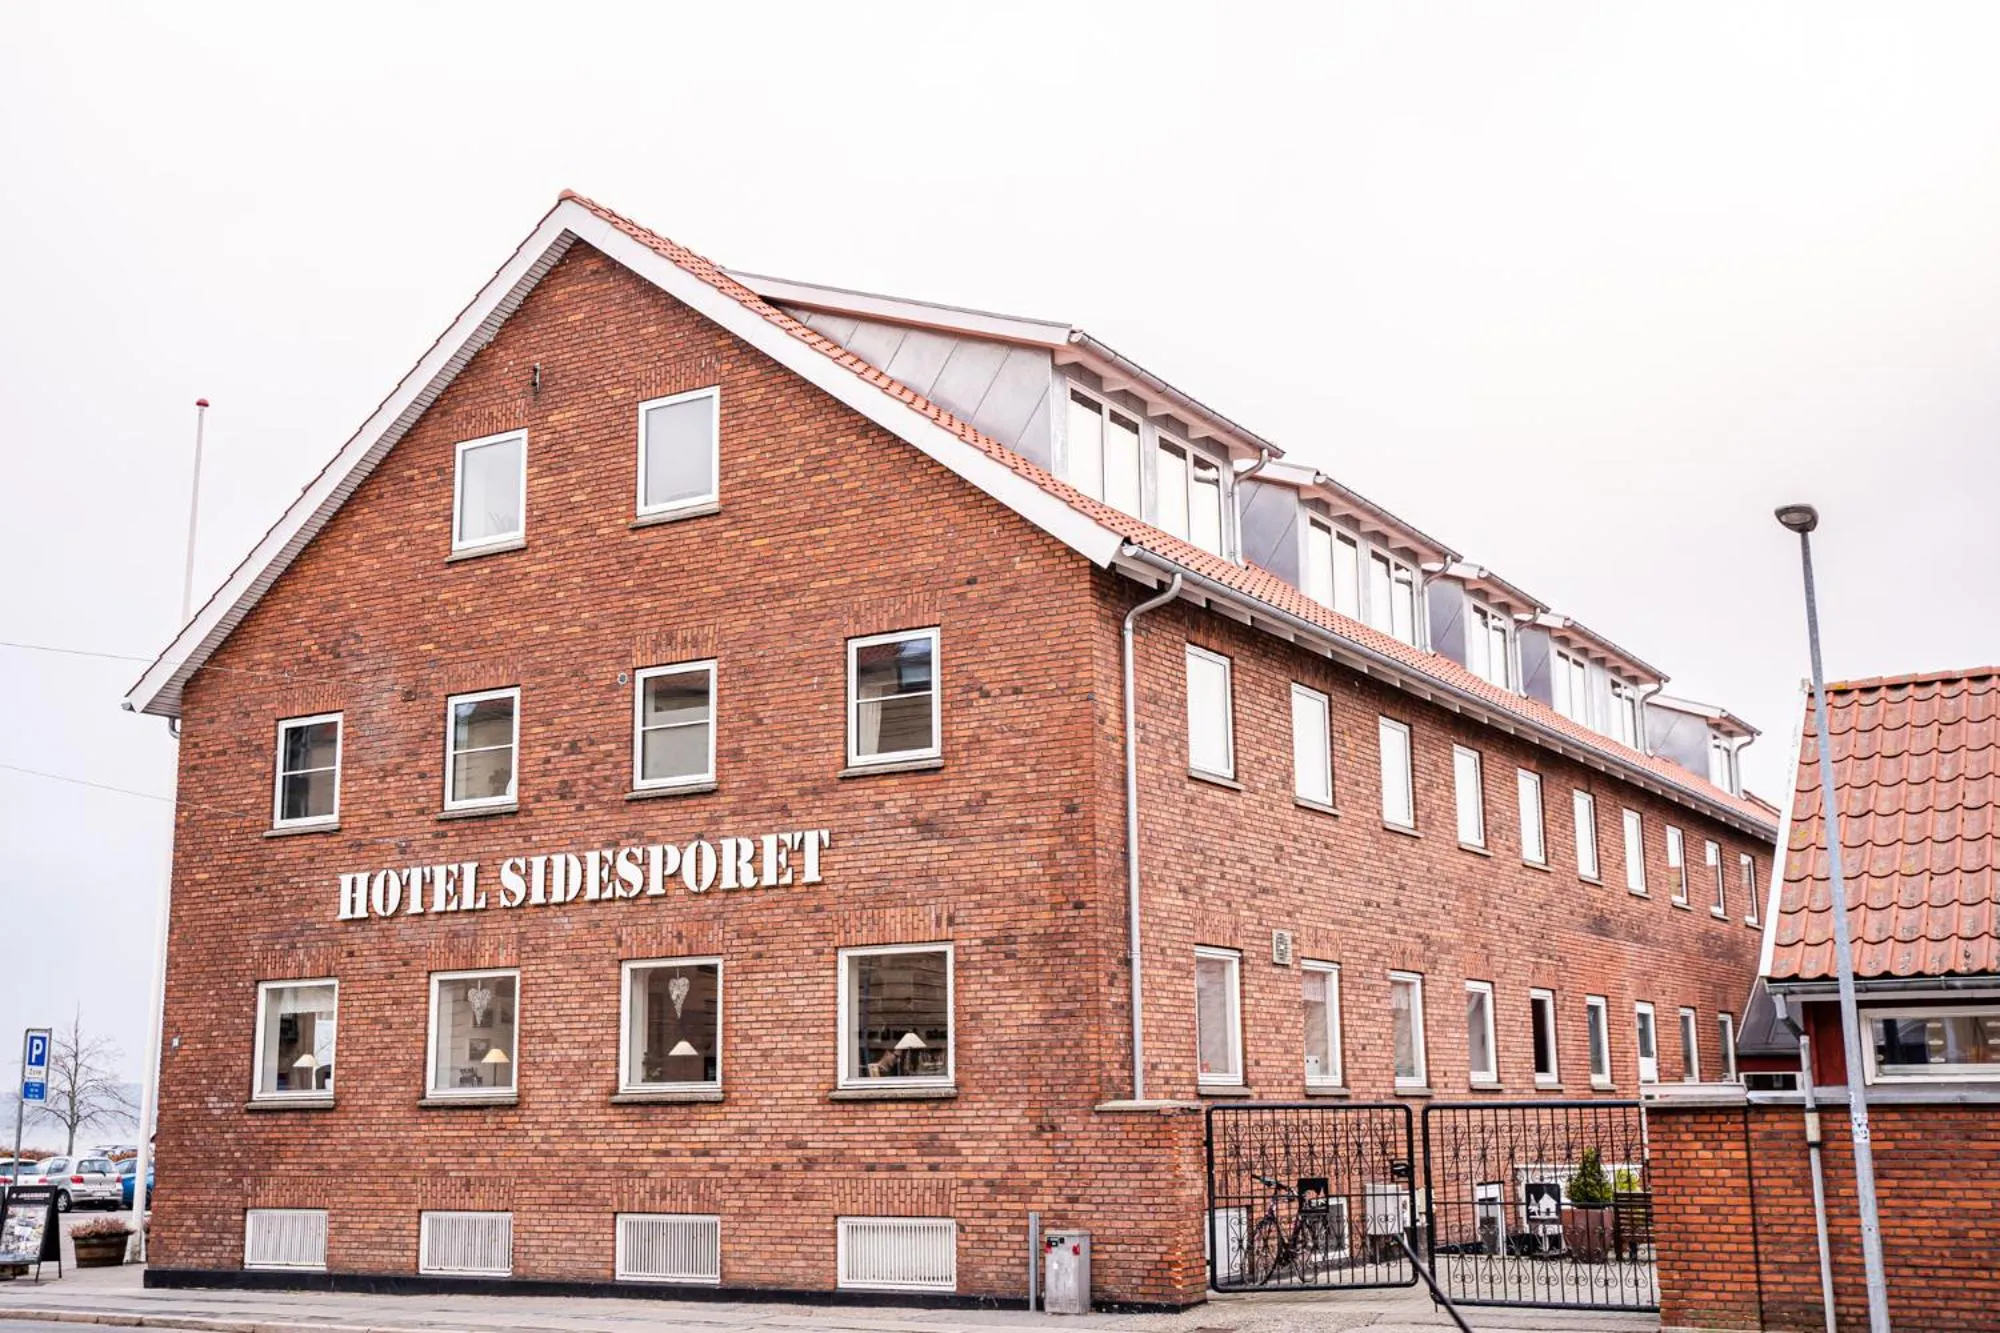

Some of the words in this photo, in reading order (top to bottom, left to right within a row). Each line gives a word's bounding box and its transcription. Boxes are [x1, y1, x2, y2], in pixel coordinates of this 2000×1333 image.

[337, 862, 487, 921] HOTEL
[500, 829, 830, 908] SIDESPORET
[31, 1038, 43, 1063] P
